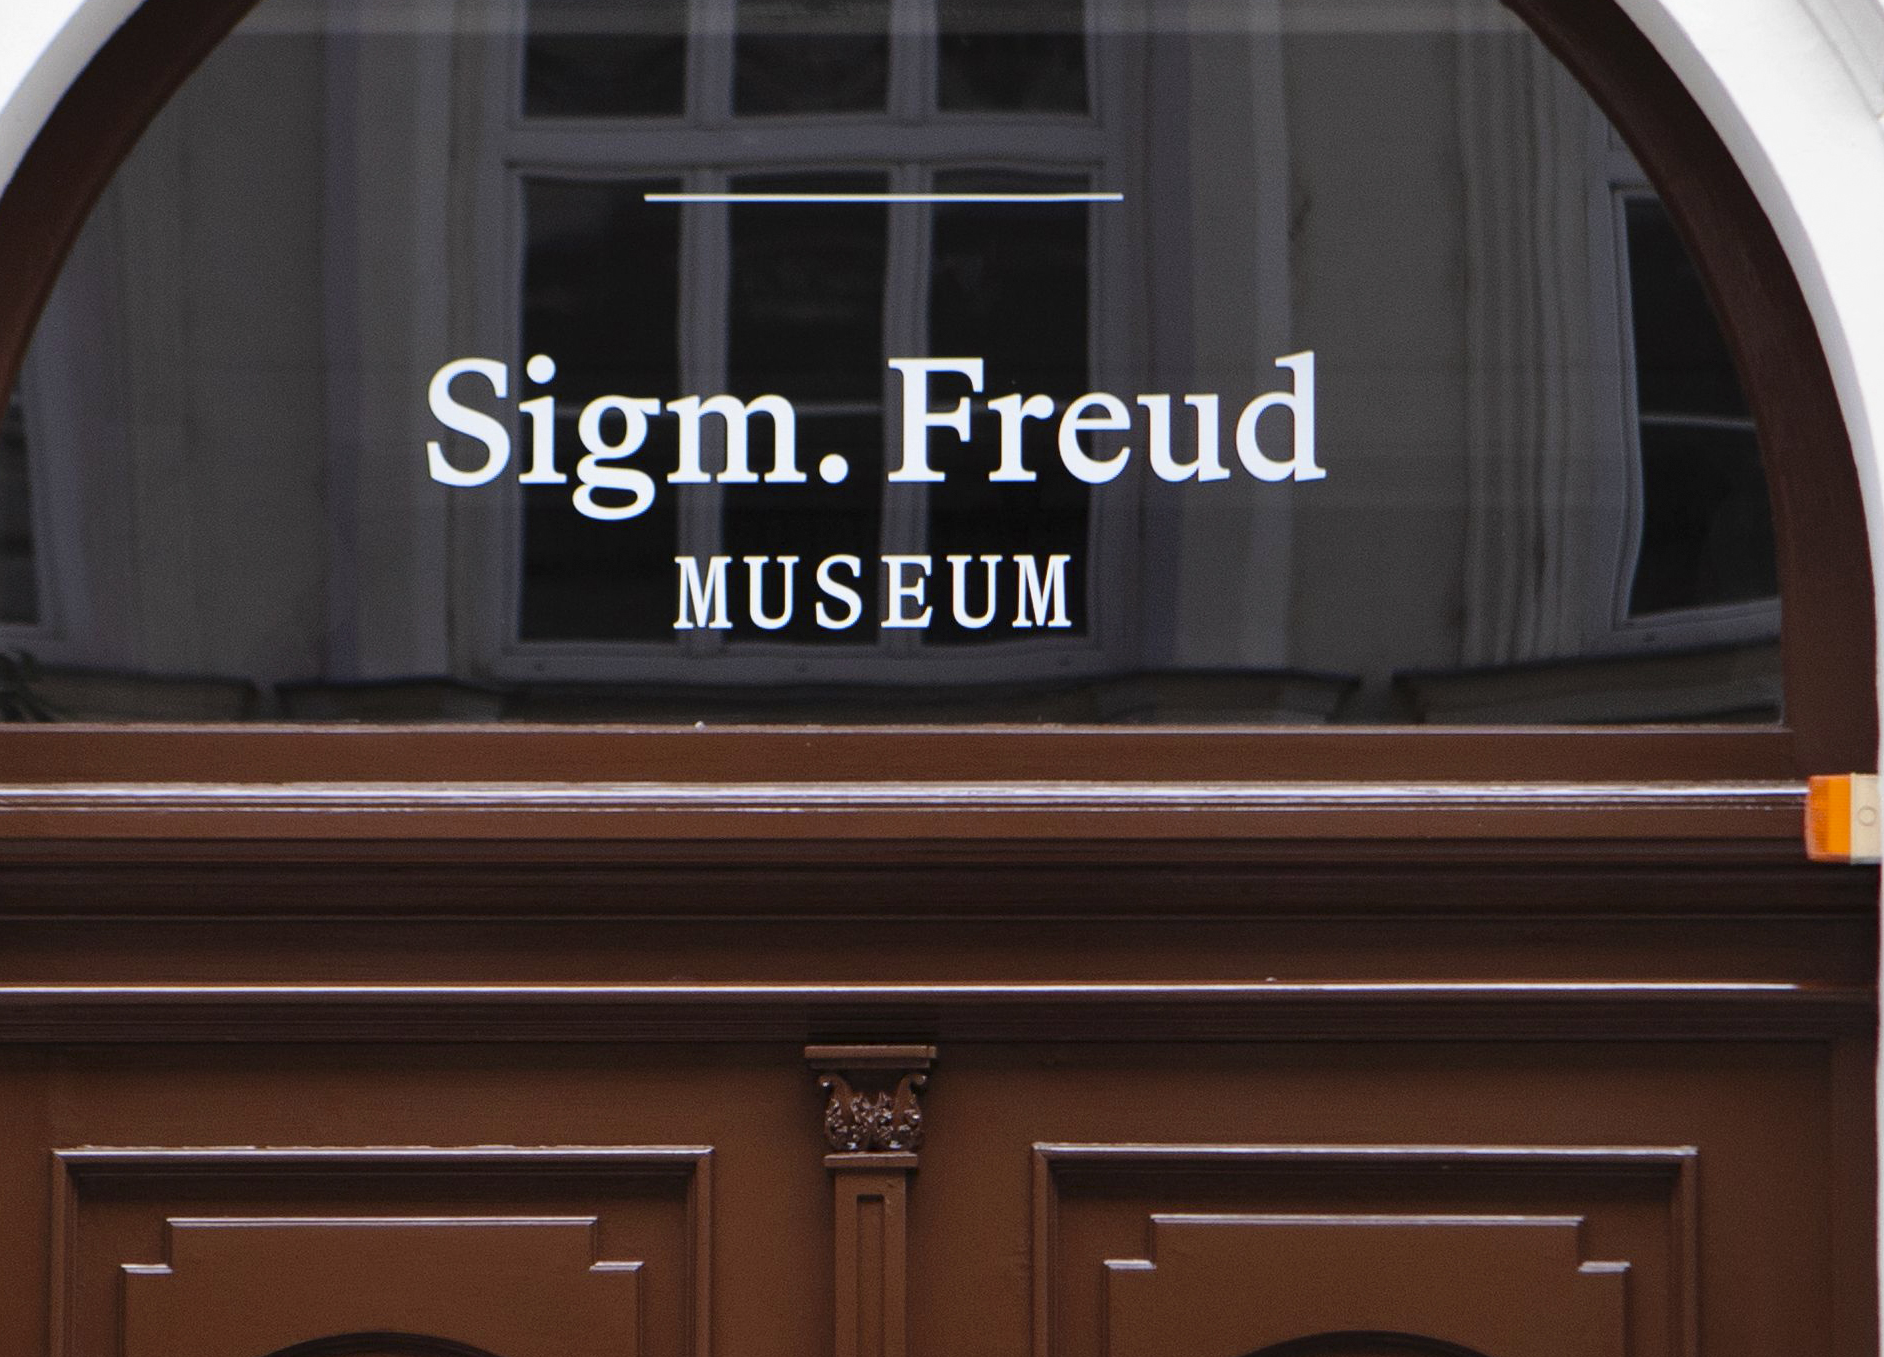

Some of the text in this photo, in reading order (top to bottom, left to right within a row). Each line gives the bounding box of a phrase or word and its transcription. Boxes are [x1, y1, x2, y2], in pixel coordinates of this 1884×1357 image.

[426, 350, 1327, 521] Sigm. Freud
[673, 554, 1072, 629] MUSEUM
